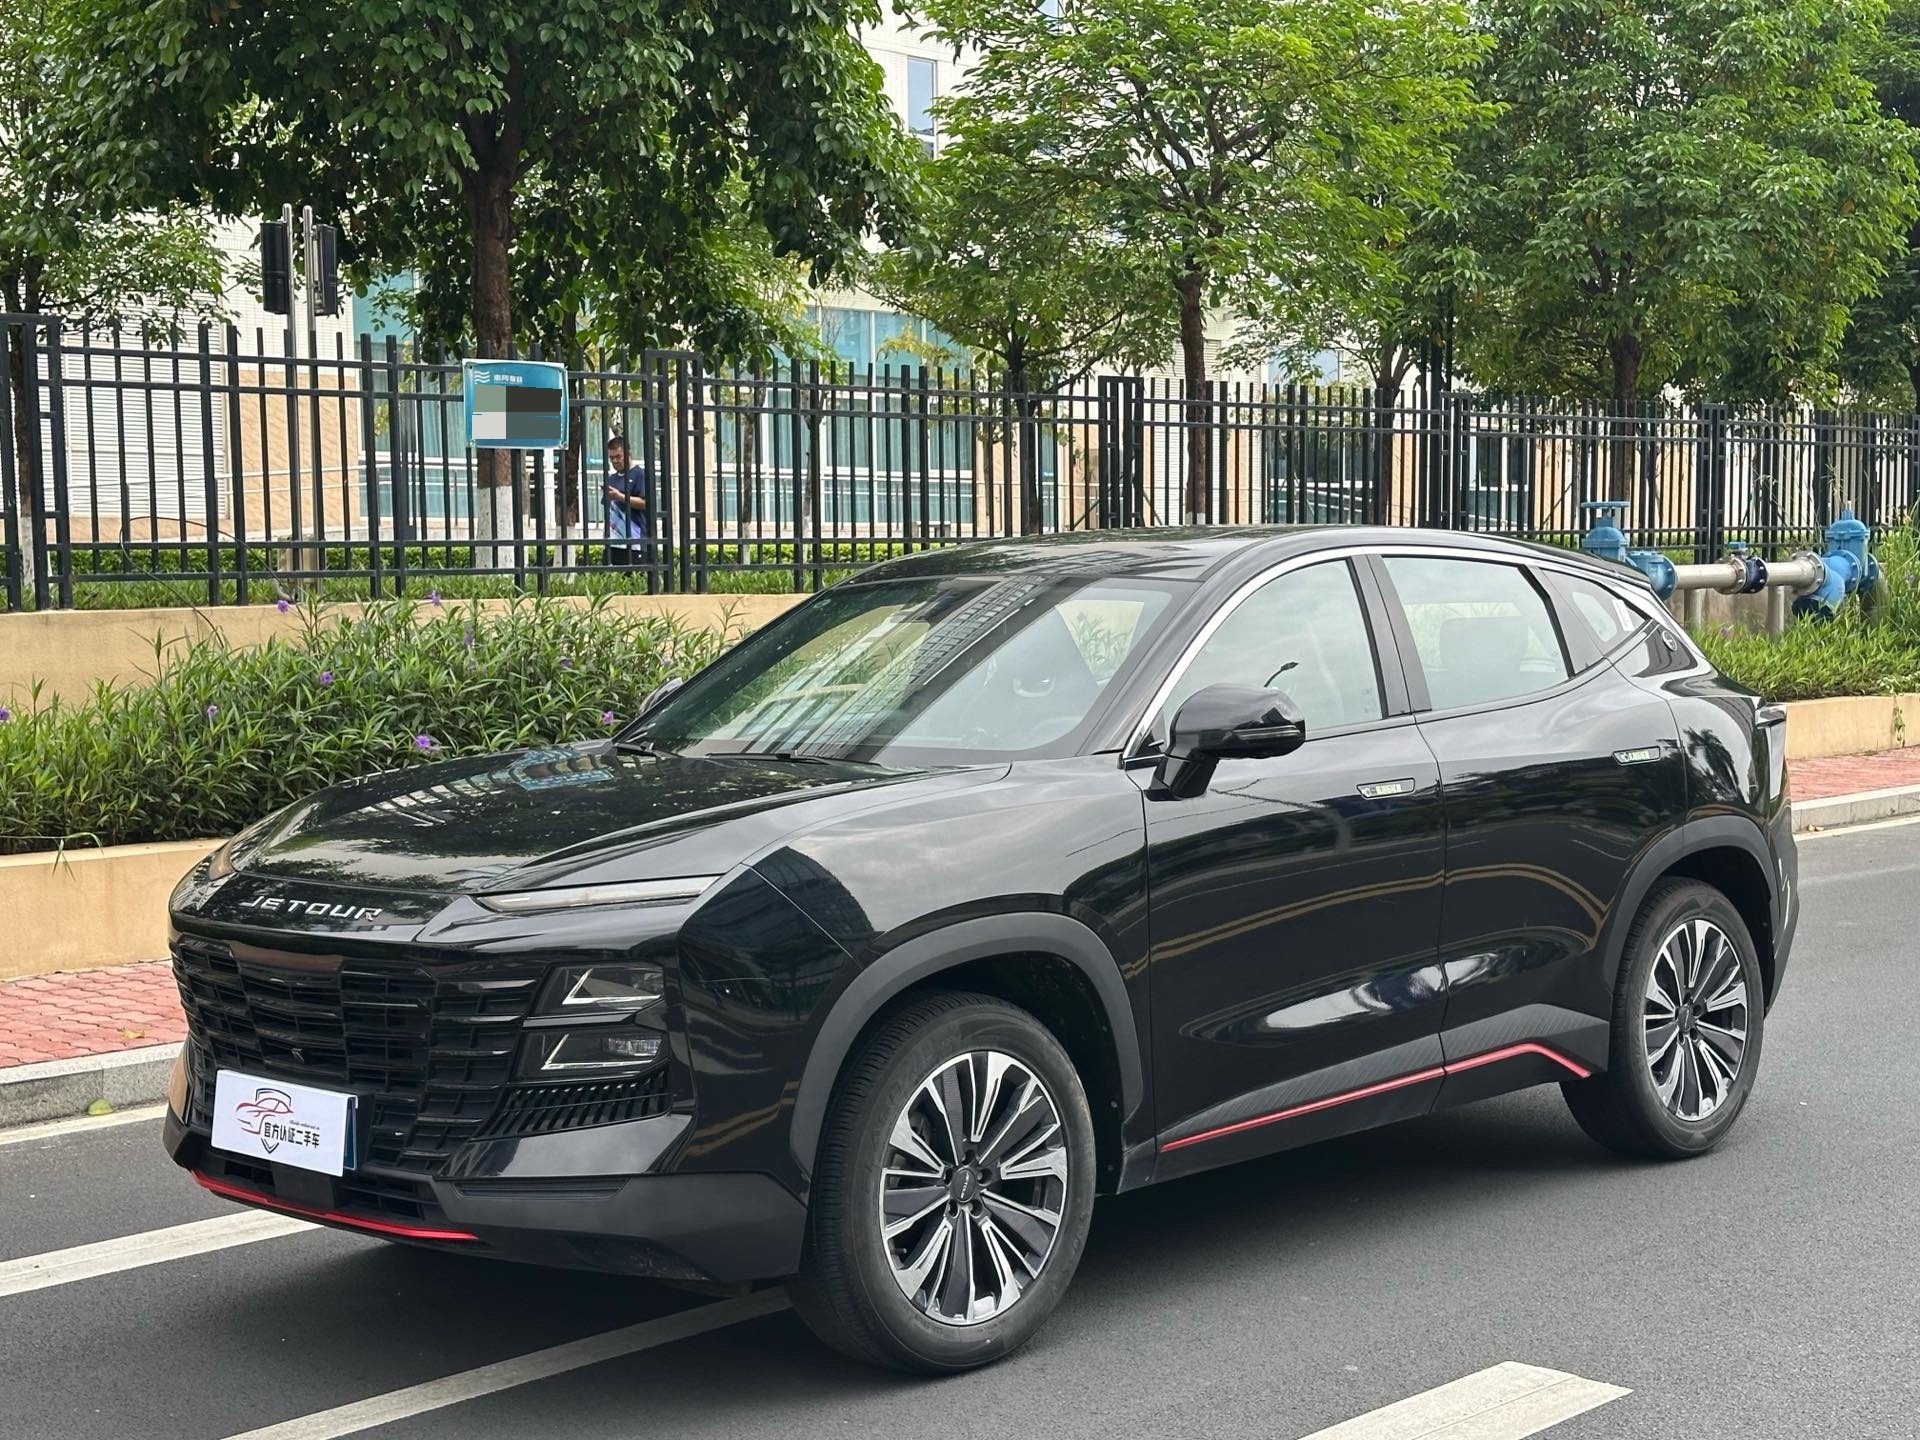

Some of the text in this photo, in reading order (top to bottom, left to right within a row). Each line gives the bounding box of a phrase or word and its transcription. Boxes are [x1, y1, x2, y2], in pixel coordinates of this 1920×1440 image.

[239, 895, 383, 922] JETOUR
[264, 1121, 321, 1149] 官方认证二手车
